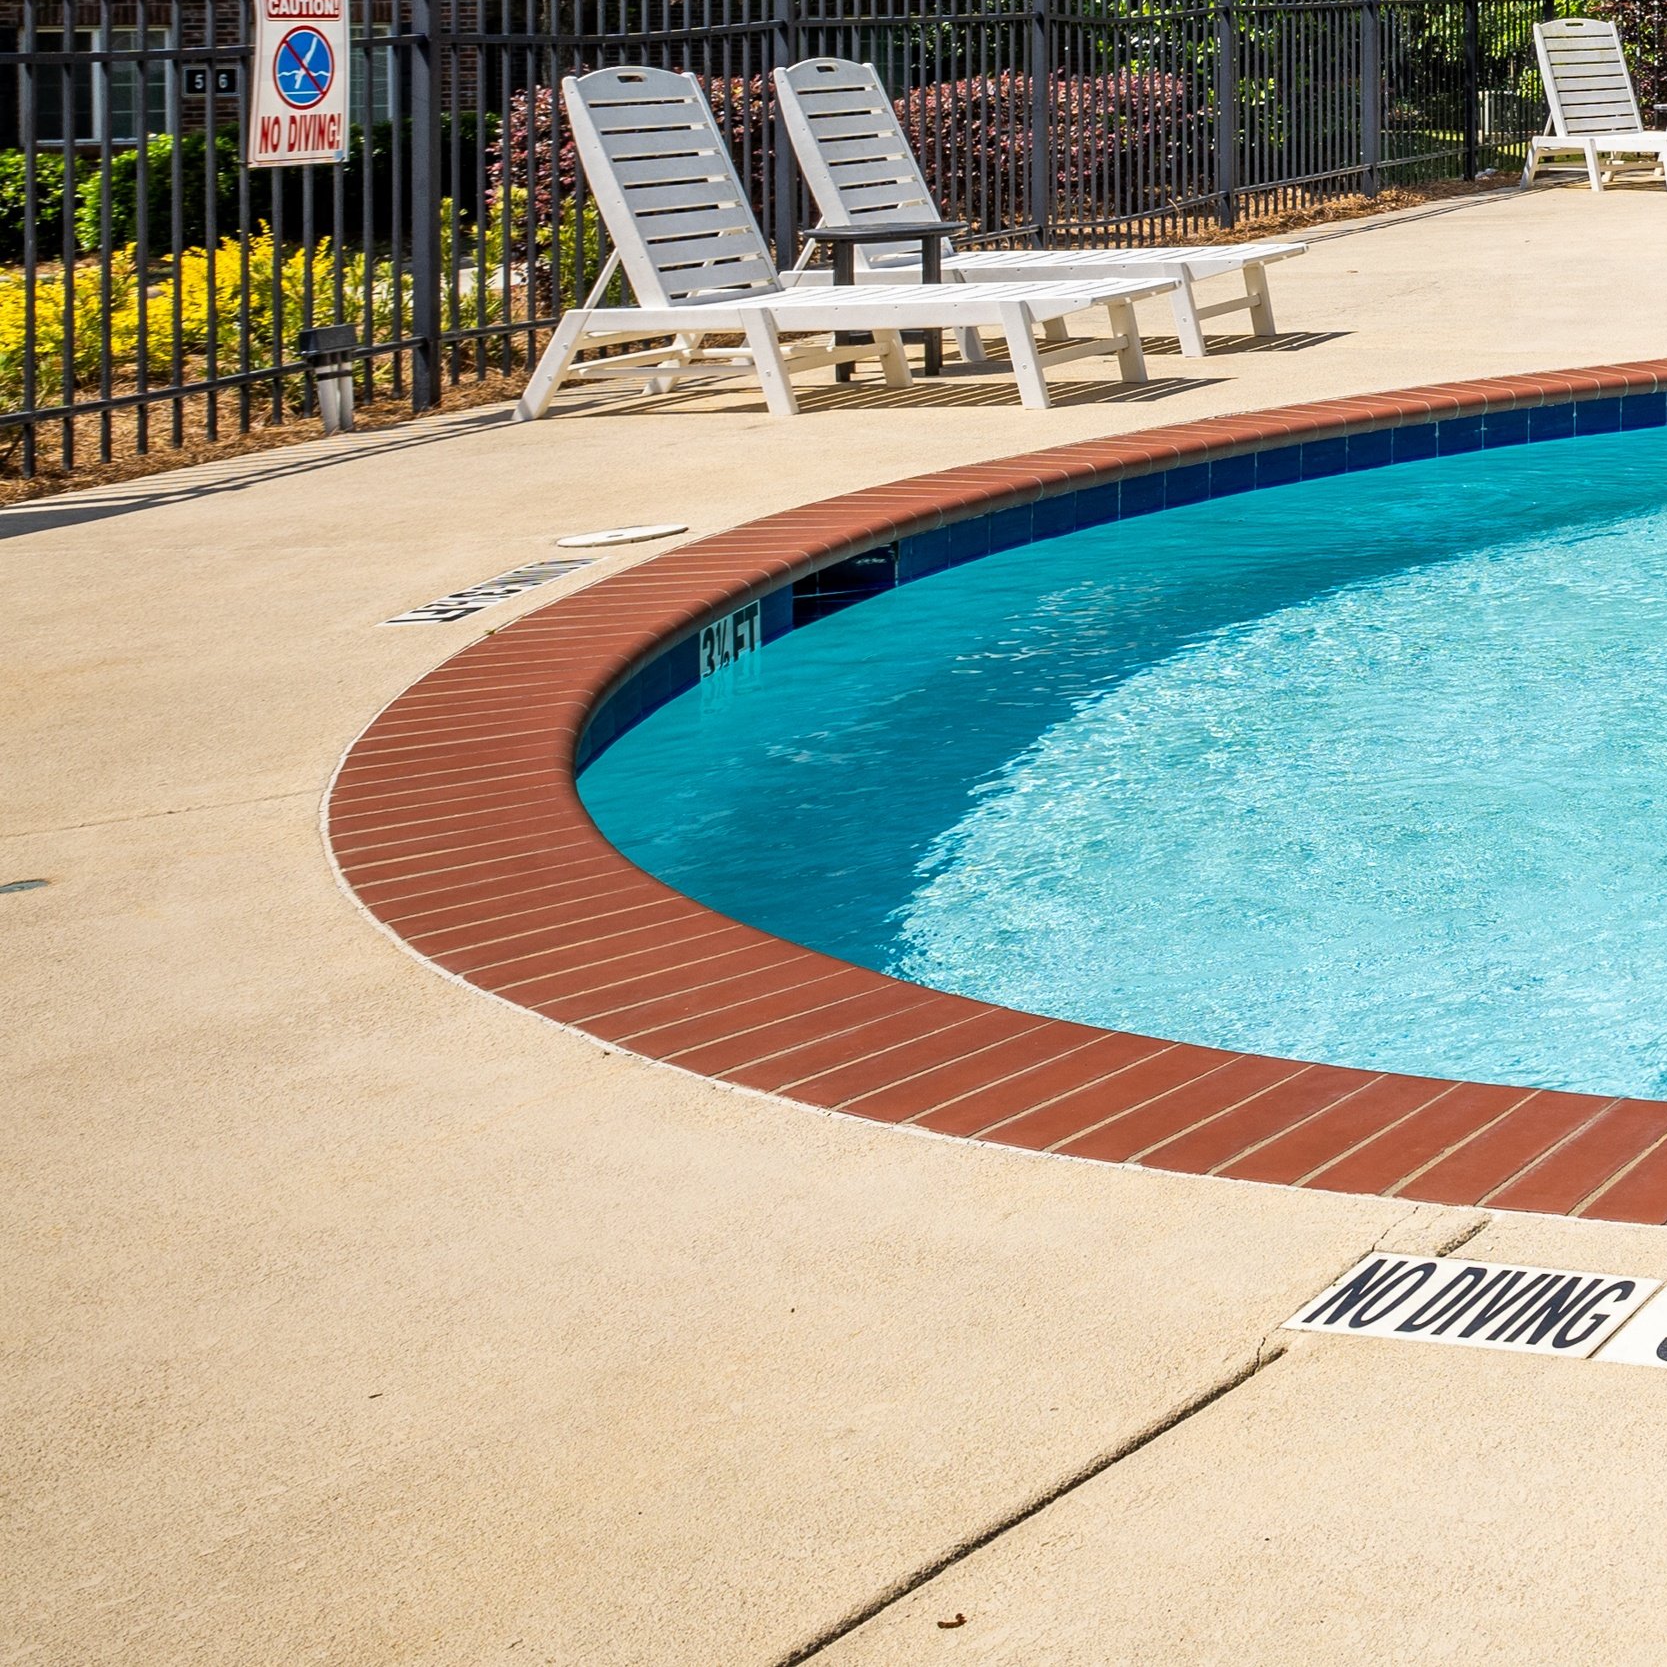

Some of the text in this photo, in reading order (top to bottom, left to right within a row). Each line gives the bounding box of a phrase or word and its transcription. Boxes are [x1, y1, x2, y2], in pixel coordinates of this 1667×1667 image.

[259, 113, 341, 154] NO DIVING!
[733, 602, 759, 662] FT
[1302, 1258, 1438, 1329] NO
[1409, 1266, 1636, 1349] DIVING
